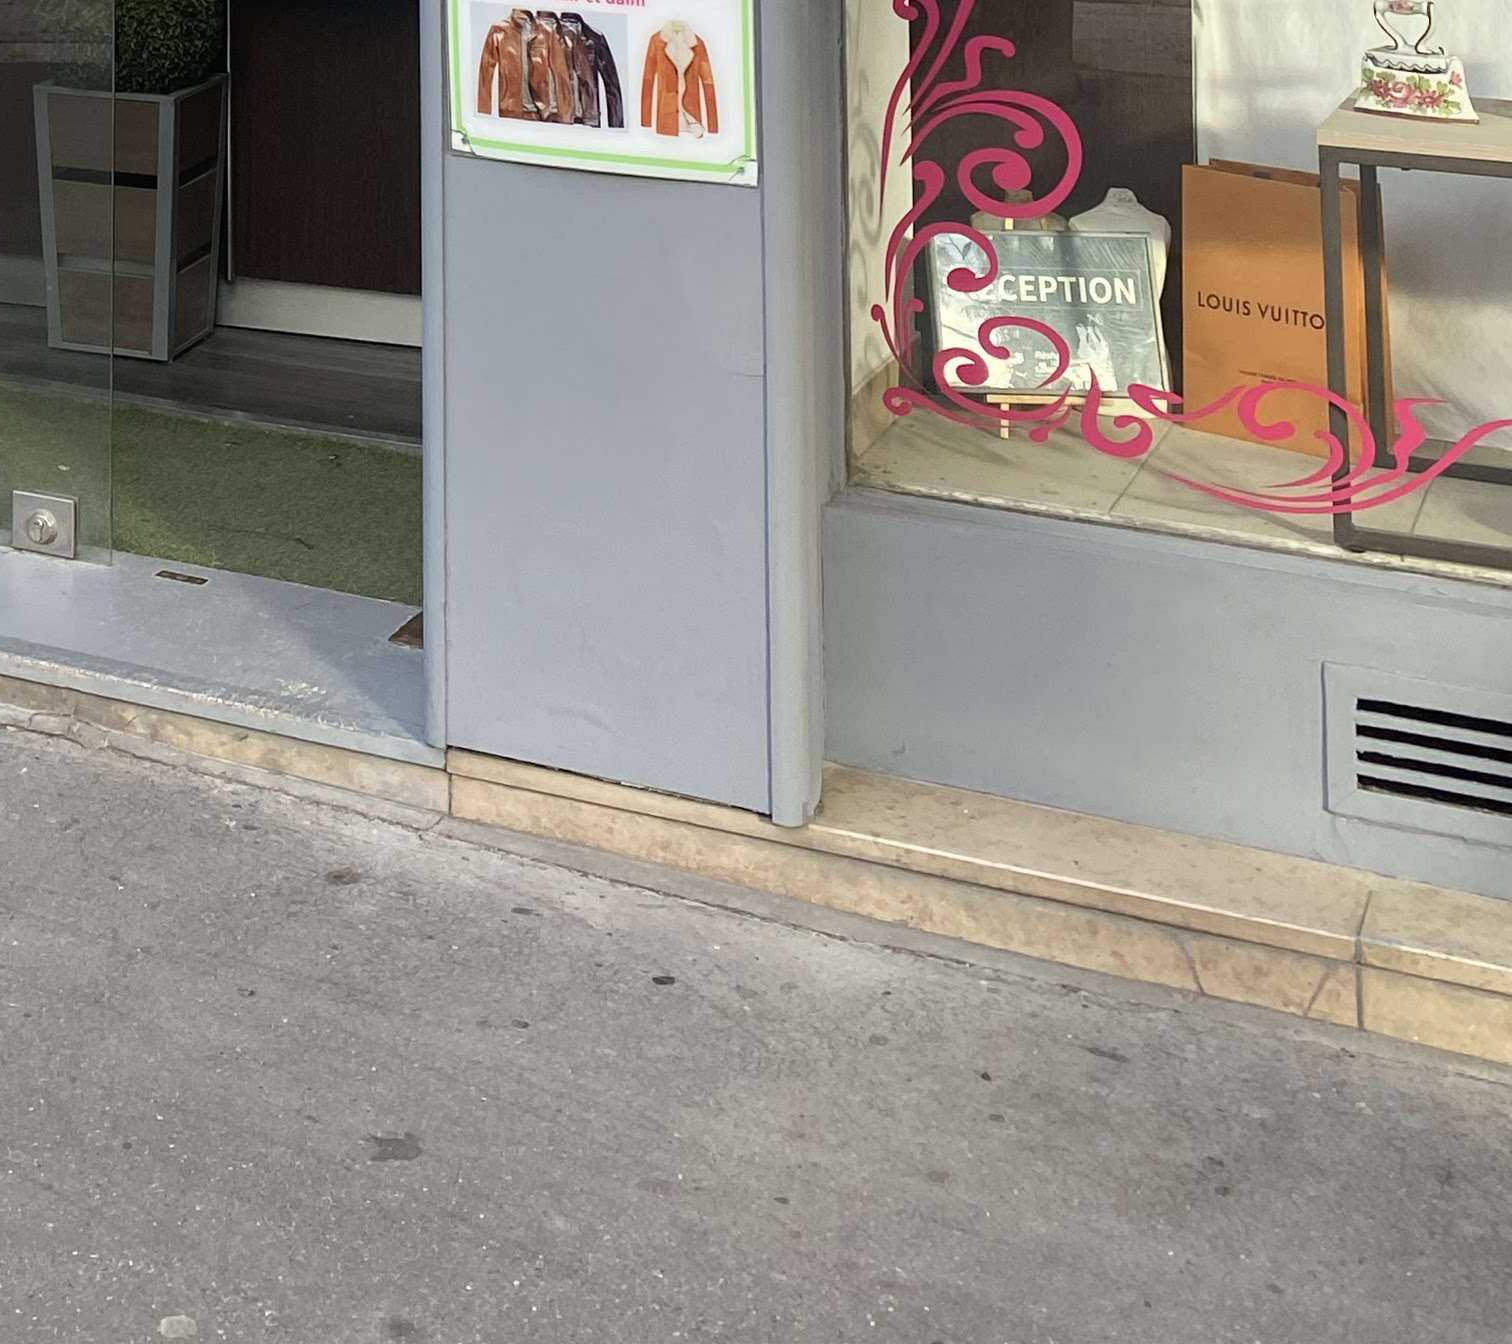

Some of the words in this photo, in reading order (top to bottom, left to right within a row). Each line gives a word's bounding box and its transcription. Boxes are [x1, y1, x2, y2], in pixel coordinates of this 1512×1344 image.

[970, 274, 1137, 305] CEPTION
[1197, 290, 1251, 316] LOUIS
[1257, 302, 1325, 330] VUITTO
